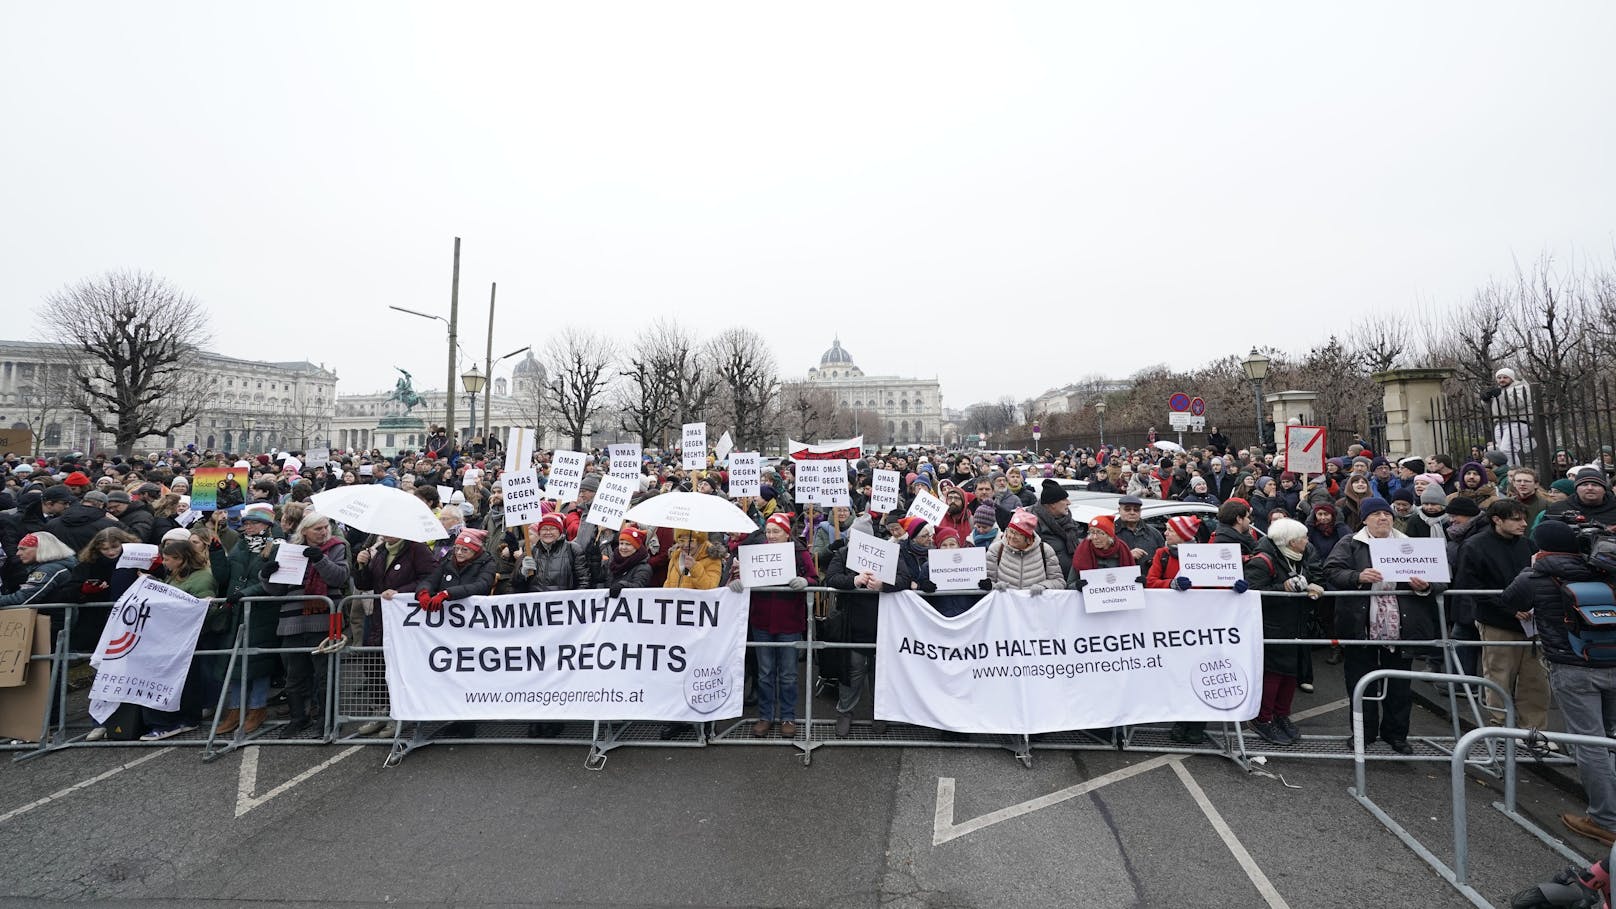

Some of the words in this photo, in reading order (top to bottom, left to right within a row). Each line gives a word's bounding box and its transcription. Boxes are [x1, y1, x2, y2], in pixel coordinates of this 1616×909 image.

[685, 429, 702, 437] OMAS
[684, 440, 704, 448] GEGEN
[683, 451, 705, 459] RECHTS
[558, 457, 579, 465] OMAS
[553, 468, 579, 477] GEGEN
[611, 472, 639, 480] RECHTS
[508, 476, 531, 487] OMAS
[549, 479, 579, 489] RECHTS
[878, 475, 895, 483] OMAS
[606, 482, 628, 493] OMAS
[875, 485, 896, 493] GEGEN
[507, 489, 535, 500] GEGEN
[600, 493, 626, 506] GEGEN
[873, 495, 897, 504] RECHTS
[506, 502, 539, 513] RECHTS
[921, 497, 941, 512] OMAS
[593, 504, 624, 518] RECHTS
[915, 504, 938, 522] GEGEN
[858, 542, 886, 559] HETZE
[751, 553, 782, 563] HETZE
[1379, 557, 1439, 565] DEMOKRATIE
[931, 566, 985, 574] MENSCHENRECHTE
[1184, 562, 1238, 570] GESCHICHTE
[752, 567, 783, 578] TÖTET
[144, 582, 169, 594] JEWISH
[1089, 584, 1137, 595] DEMOKRATIE
[402, 597, 720, 629] ZUSAMMENHALTEN
[899, 637, 989, 661] ABSTAND
[996, 638, 1067, 657] HALTEN
[1073, 632, 1146, 654] GEGEN
[1153, 627, 1241, 648] RECHTS
[428, 646, 546, 672] GEGEN
[557, 642, 687, 673] RECHTS
[972, 653, 1163, 680] www.omasgegenrechts.at
[1199, 658, 1232, 673] OMAS
[693, 665, 722, 678] OMAS
[692, 677, 725, 691] GEGEN
[1201, 671, 1238, 687] GEGEN
[465, 687, 644, 705] www.omasgegenrechts.at
[691, 689, 727, 705] RECHTS
[1204, 684, 1244, 701] RECHTS
